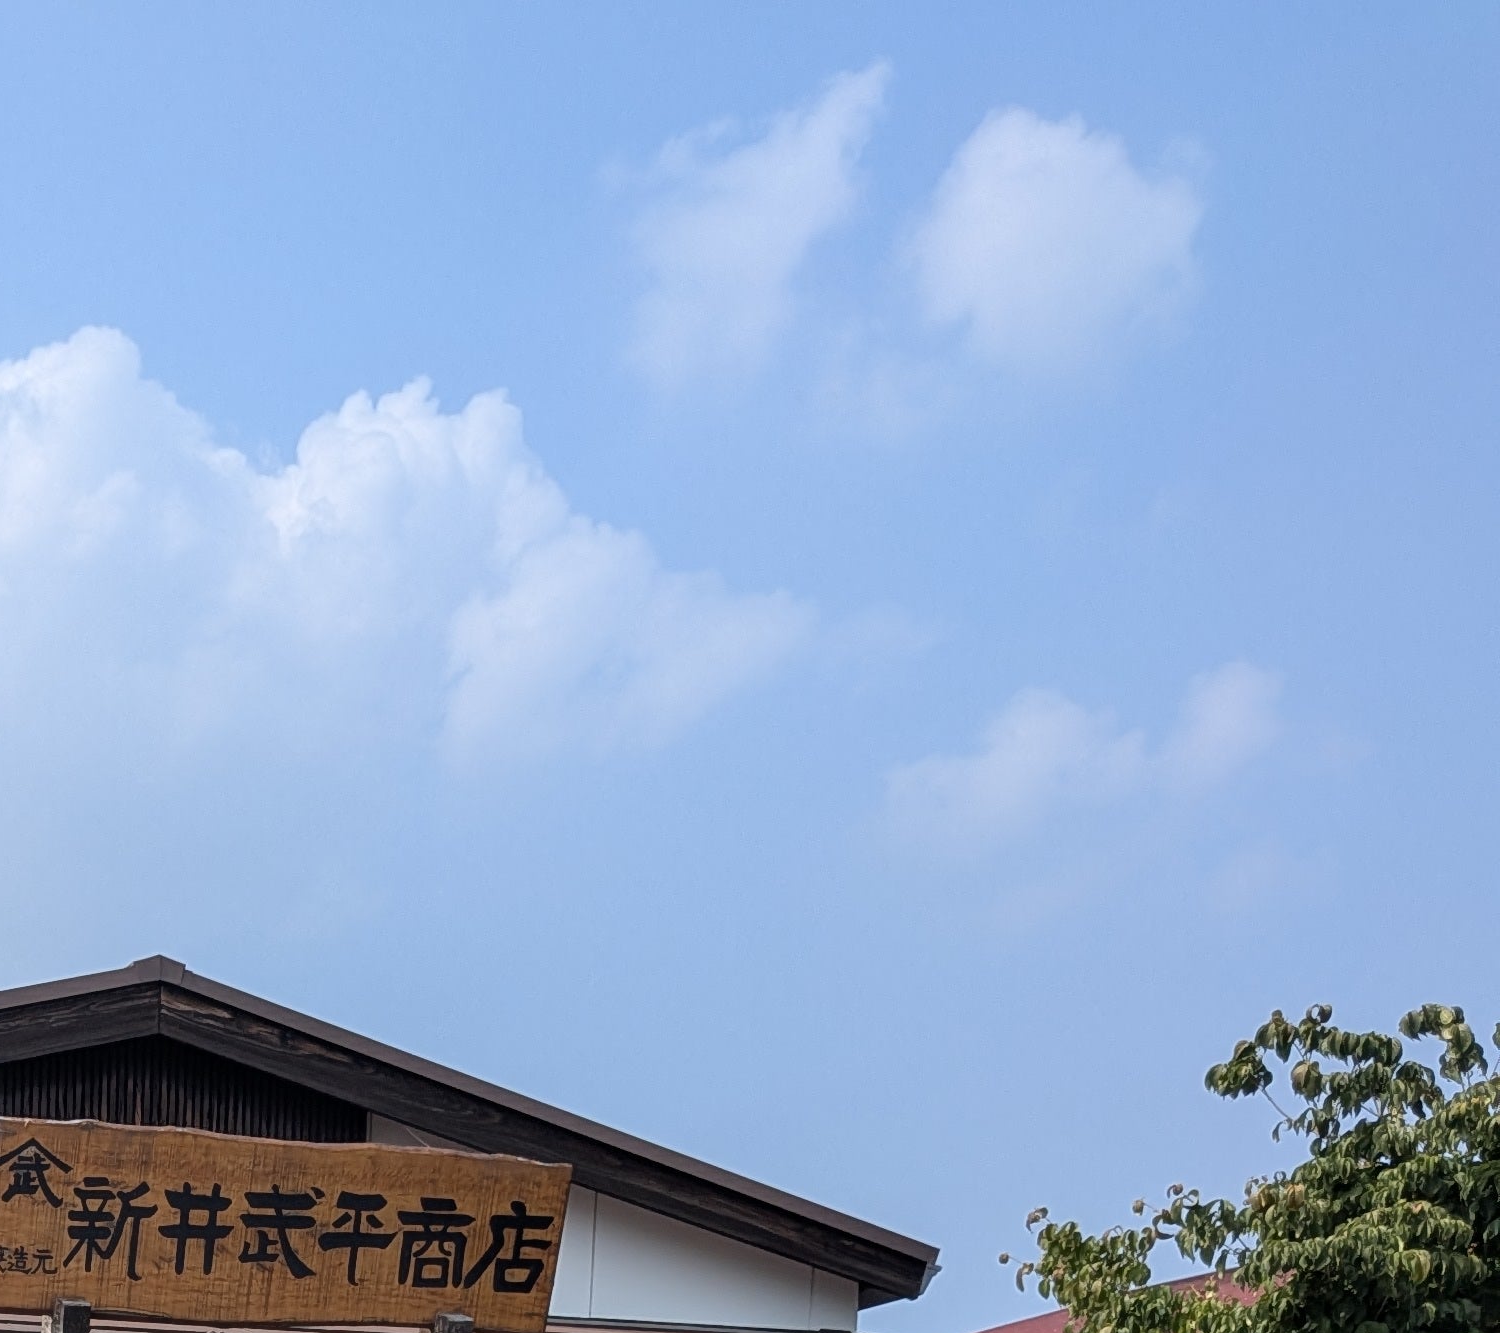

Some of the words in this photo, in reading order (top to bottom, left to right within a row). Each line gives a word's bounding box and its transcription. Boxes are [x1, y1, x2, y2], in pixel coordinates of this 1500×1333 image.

[63, 1176, 555, 1294] 新井武平商店
